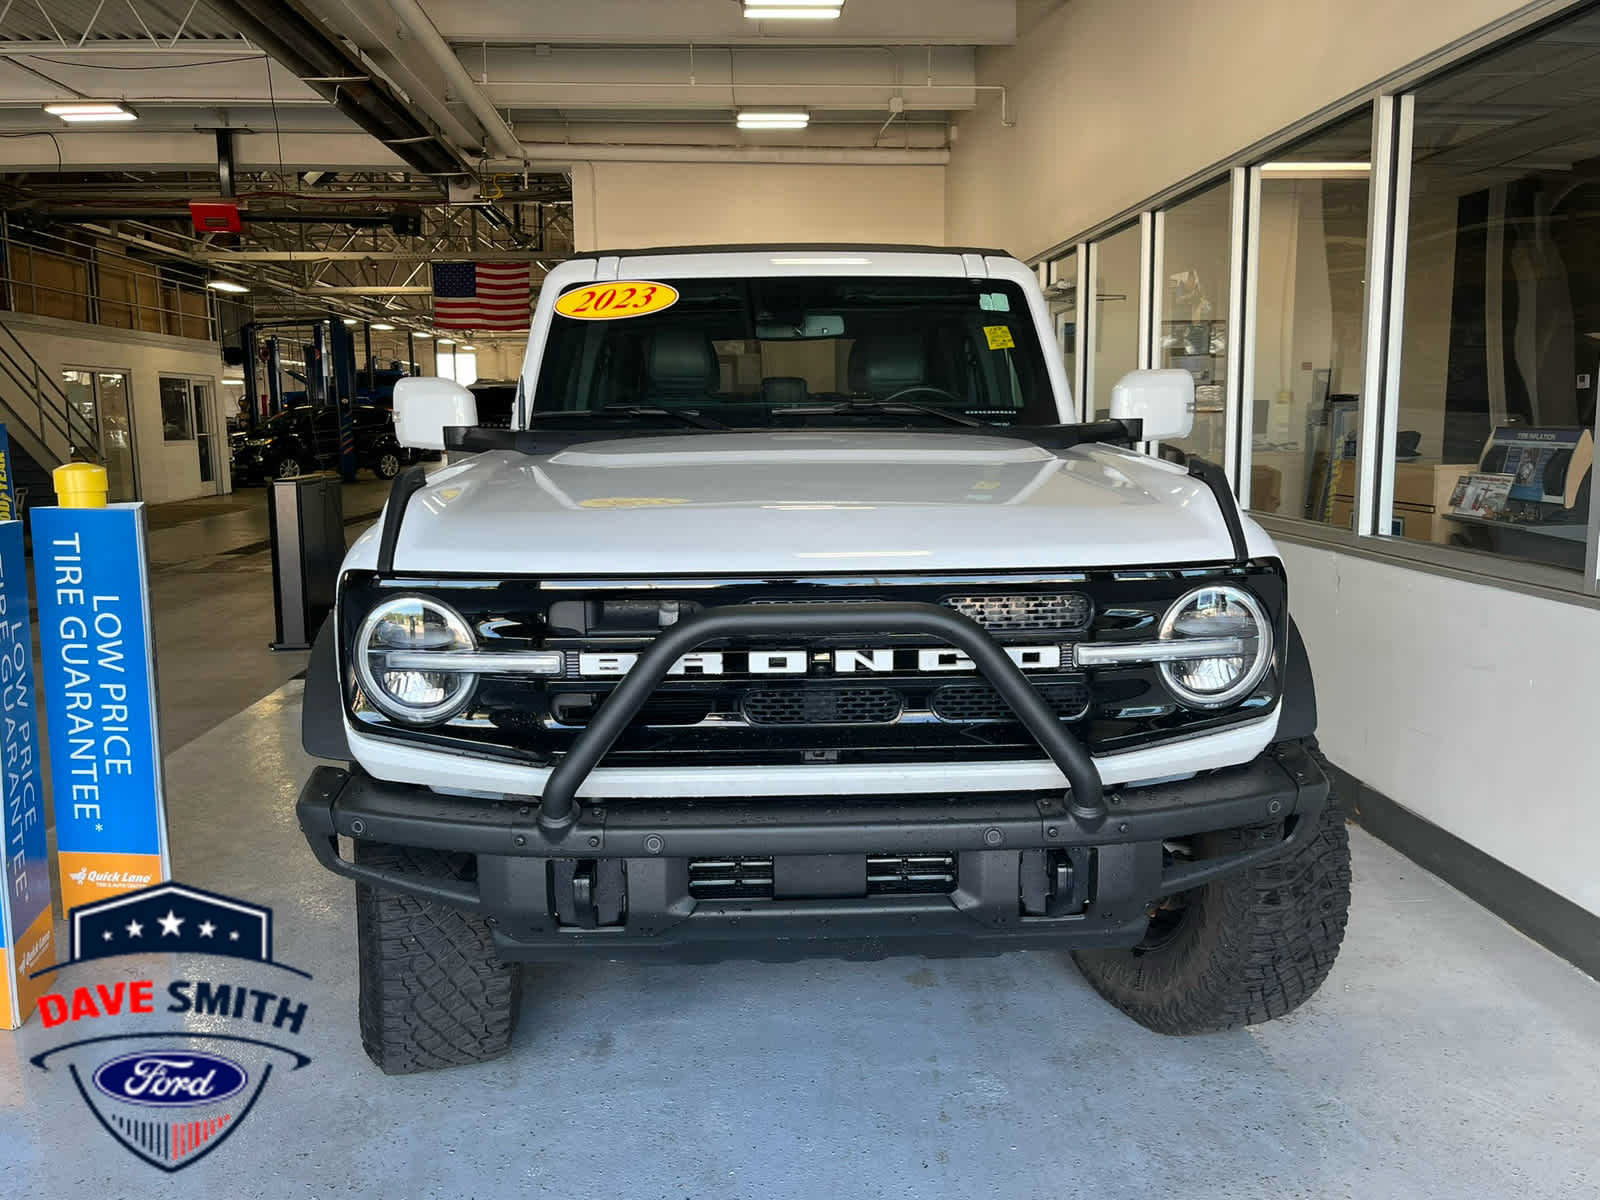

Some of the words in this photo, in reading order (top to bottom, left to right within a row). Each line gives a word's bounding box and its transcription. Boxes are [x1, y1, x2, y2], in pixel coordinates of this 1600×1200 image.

[573, 287, 657, 312] 2023
[52, 532, 85, 605] TIRE
[11, 621, 29, 708] LOW
[92, 595, 125, 673] LOW
[578, 644, 1062, 677] BRONCO
[99, 683, 132, 775] PRICE
[18, 720, 37, 833] PRICE
[87, 870, 120, 882] Quick
[121, 872, 151, 883] Lane
